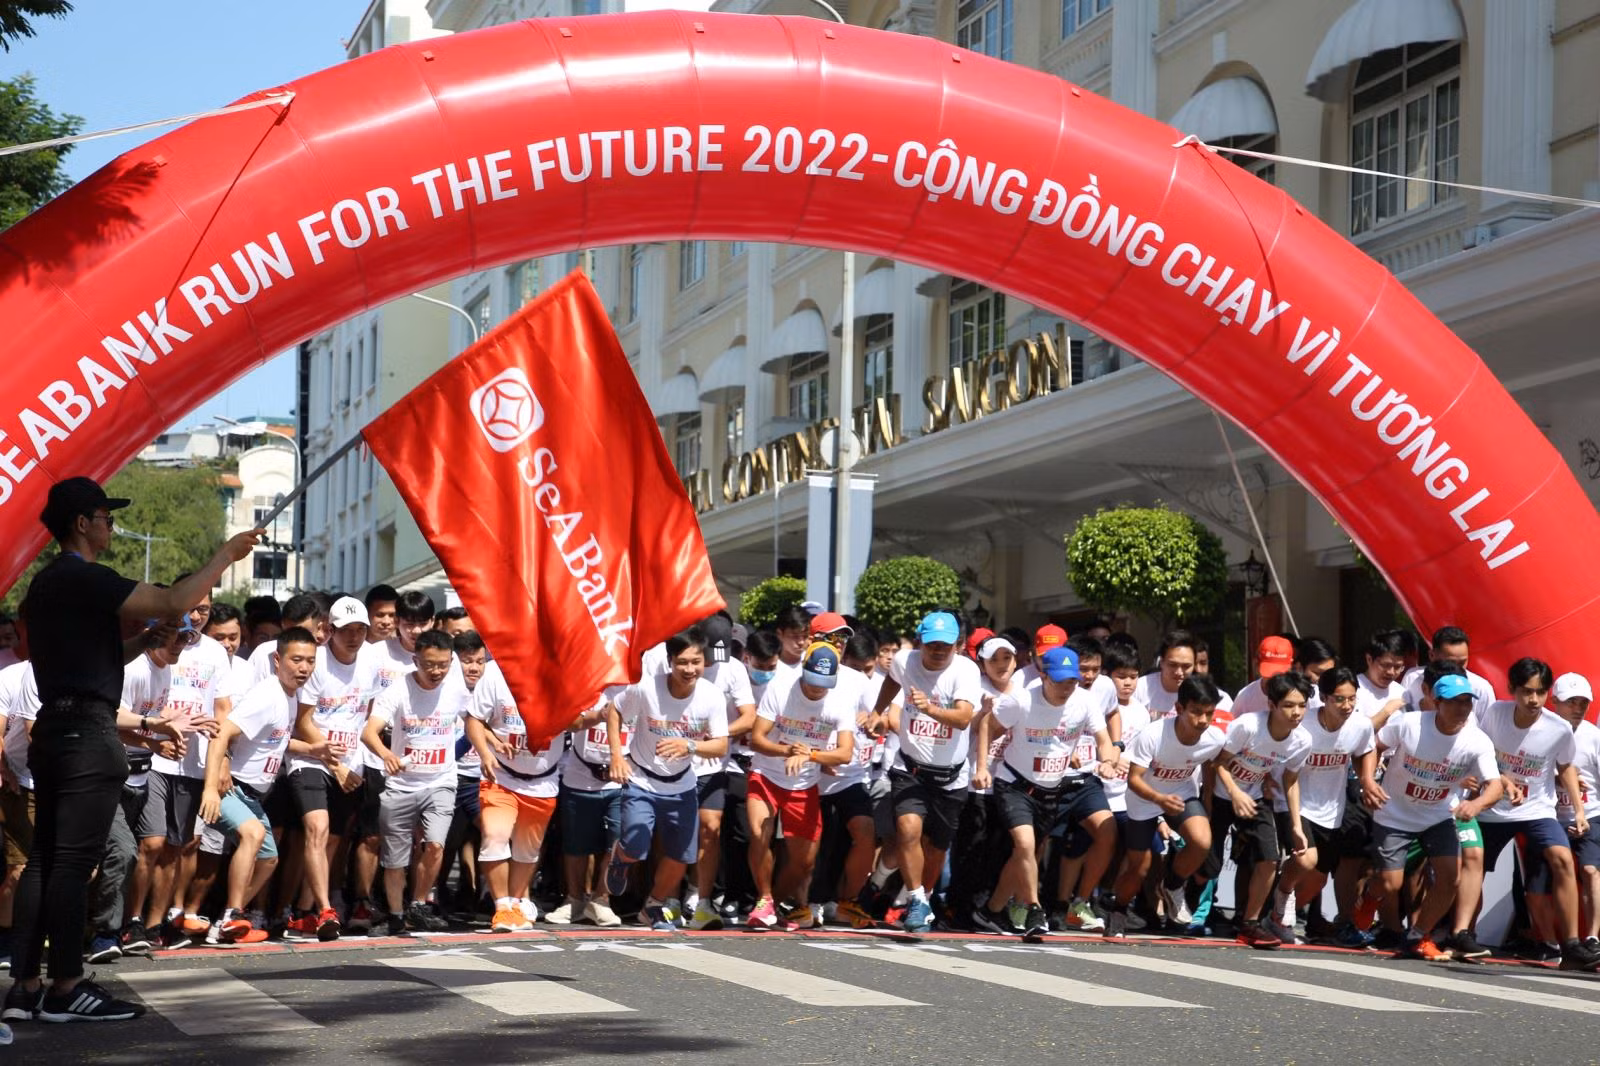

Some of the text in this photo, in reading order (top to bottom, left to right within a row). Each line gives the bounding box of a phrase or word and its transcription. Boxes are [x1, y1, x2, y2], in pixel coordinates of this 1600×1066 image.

[179, 232, 294, 328] RUN
[298, 187, 408, 265] FOR
[411, 149, 518, 219] THE
[526, 125, 726, 190] FUTURE
[893, 138, 1028, 213] CỘNG
[1028, 173, 1165, 267] ĐỒNG
[1161, 242, 1291, 335] CHẠY
[1286, 316, 1341, 376] VÌ
[1328, 352, 1470, 500] TƯƠNG
[1449, 487, 1531, 570] LAI
[921, 323, 1072, 436] SAIGON
[517, 447, 634, 657] SeABank
[1412, 785, 1443, 801] 0792
